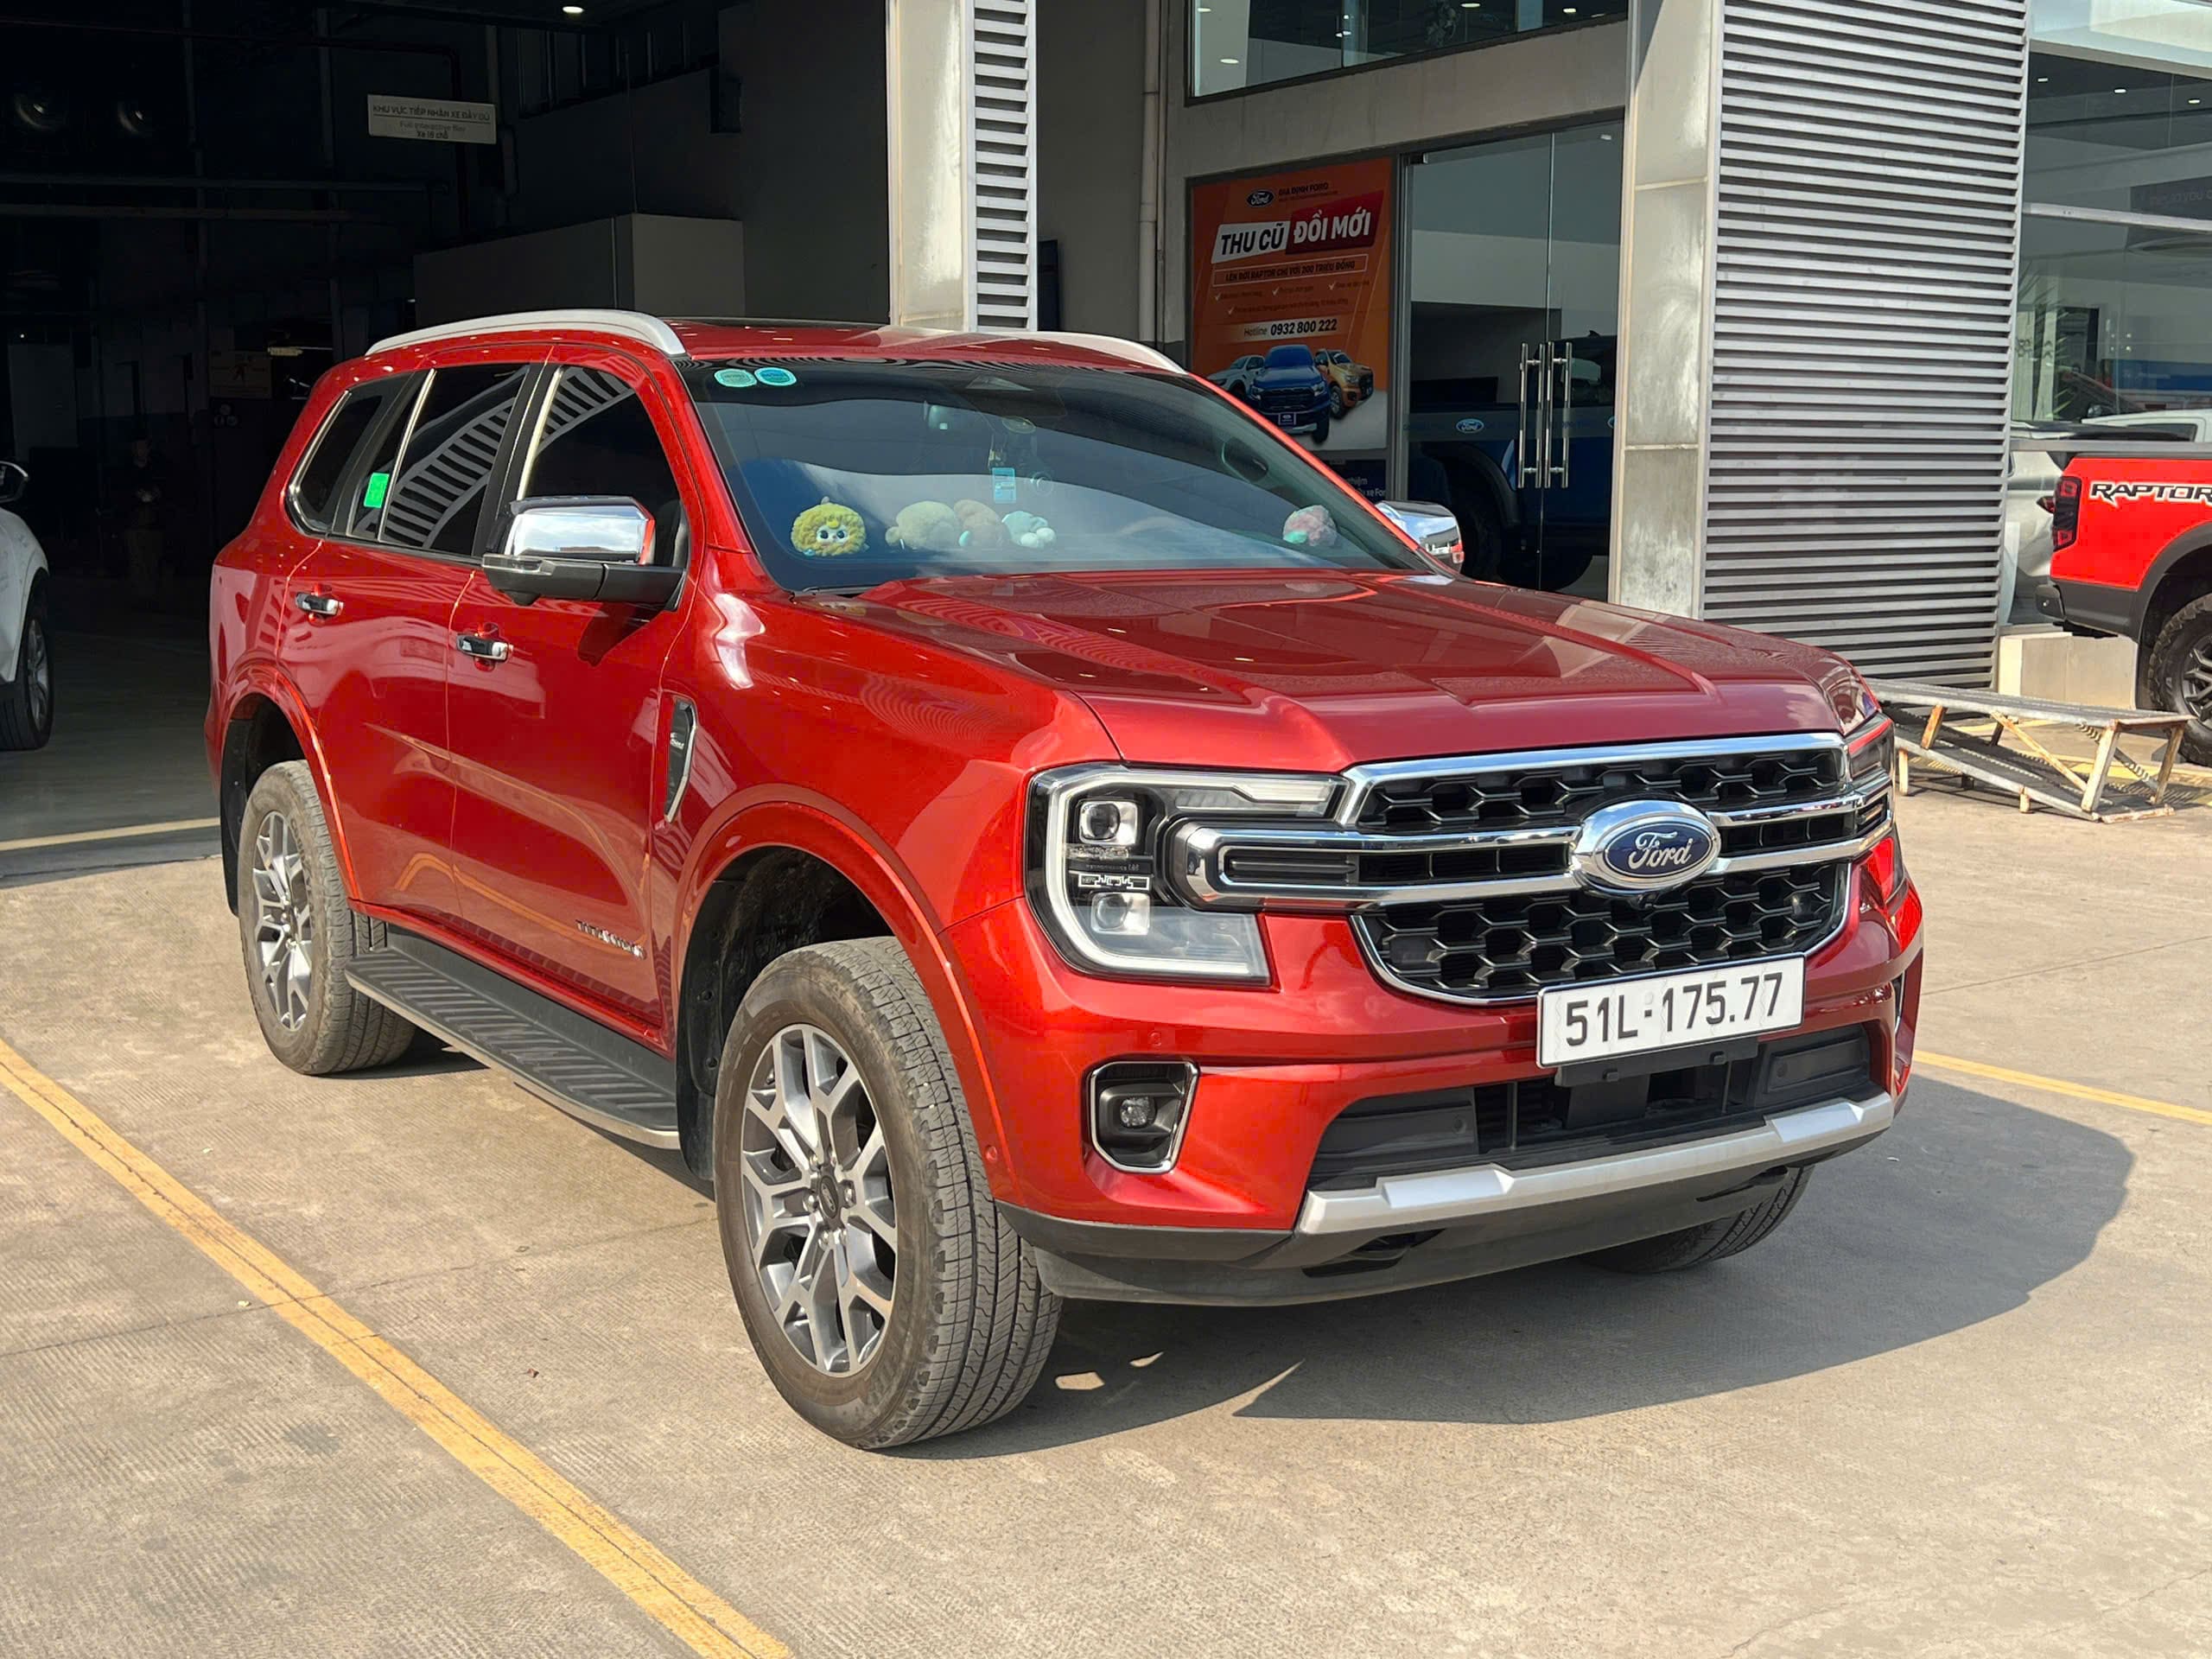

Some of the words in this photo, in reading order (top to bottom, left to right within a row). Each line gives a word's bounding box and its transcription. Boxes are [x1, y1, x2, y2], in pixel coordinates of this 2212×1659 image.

[1310, 182, 1329, 193] FORD
[1221, 230, 1255, 255] THU
[1259, 222, 1285, 251] CŨ
[1331, 206, 1371, 239] MỚI
[1244, 326, 1268, 337] Hotline
[1270, 322, 1295, 336] 0932
[1297, 321, 1316, 334] 800
[1319, 318, 1338, 331] 222
[2089, 481, 2212, 506] RAPTOR
[1628, 830, 1694, 869] Ford
[1566, 971, 1783, 1046] 51L-175.77
